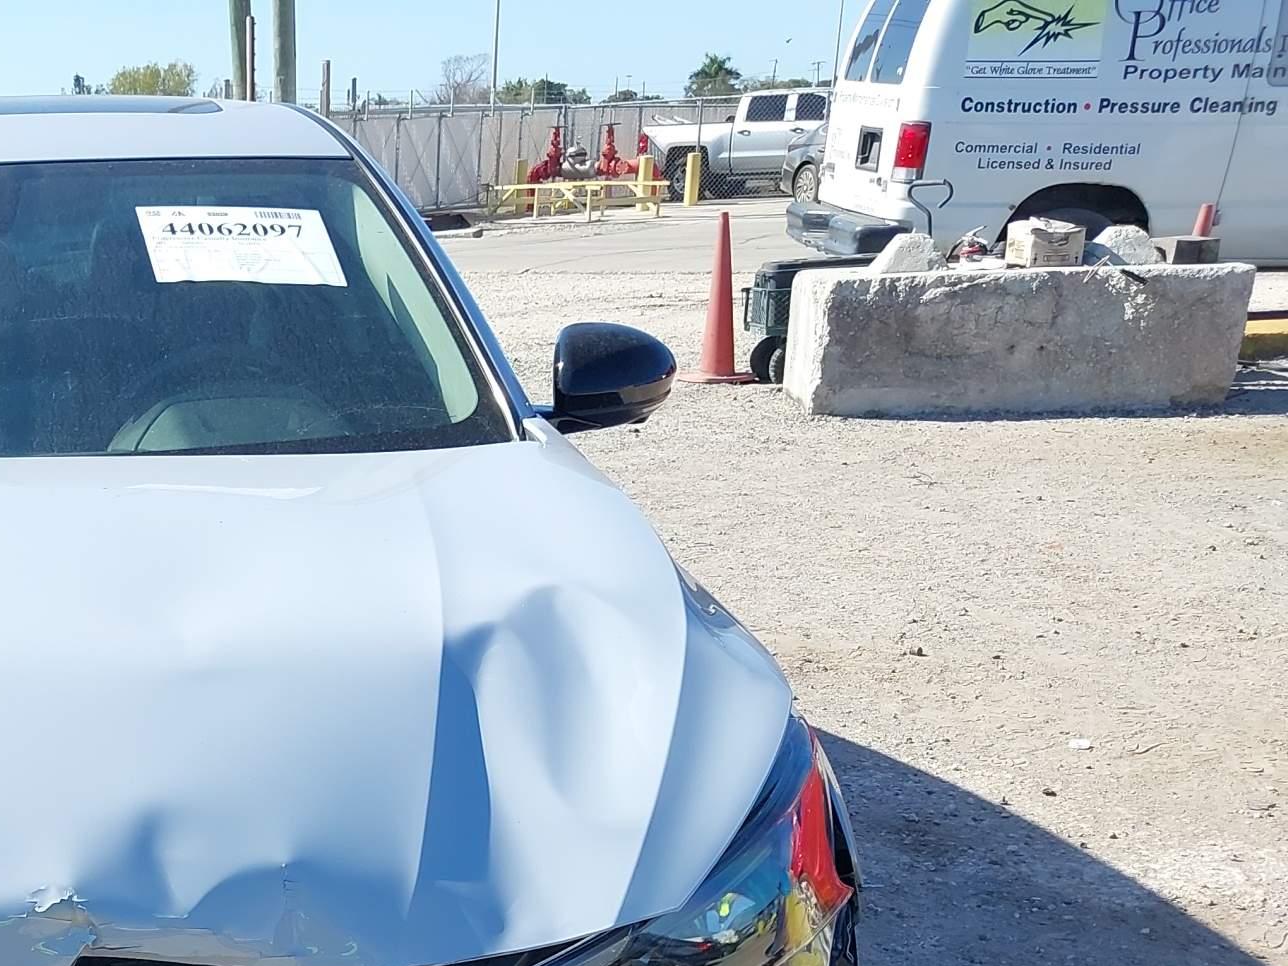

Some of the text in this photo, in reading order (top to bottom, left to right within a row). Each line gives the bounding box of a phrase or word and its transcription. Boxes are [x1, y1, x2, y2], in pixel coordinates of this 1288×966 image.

[1118, 10, 1273, 62] Professionals
[990, 62, 1015, 76] White
[1016, 62, 1044, 75] Glove
[1123, 64, 1224, 83] Property
[960, 97, 1279, 116] Construction Pressure Cleaning
[954, 141, 1141, 155] Commercial Residential
[977, 157, 1113, 171] Licensed & Insured
[162, 222, 303, 238] 44062097
